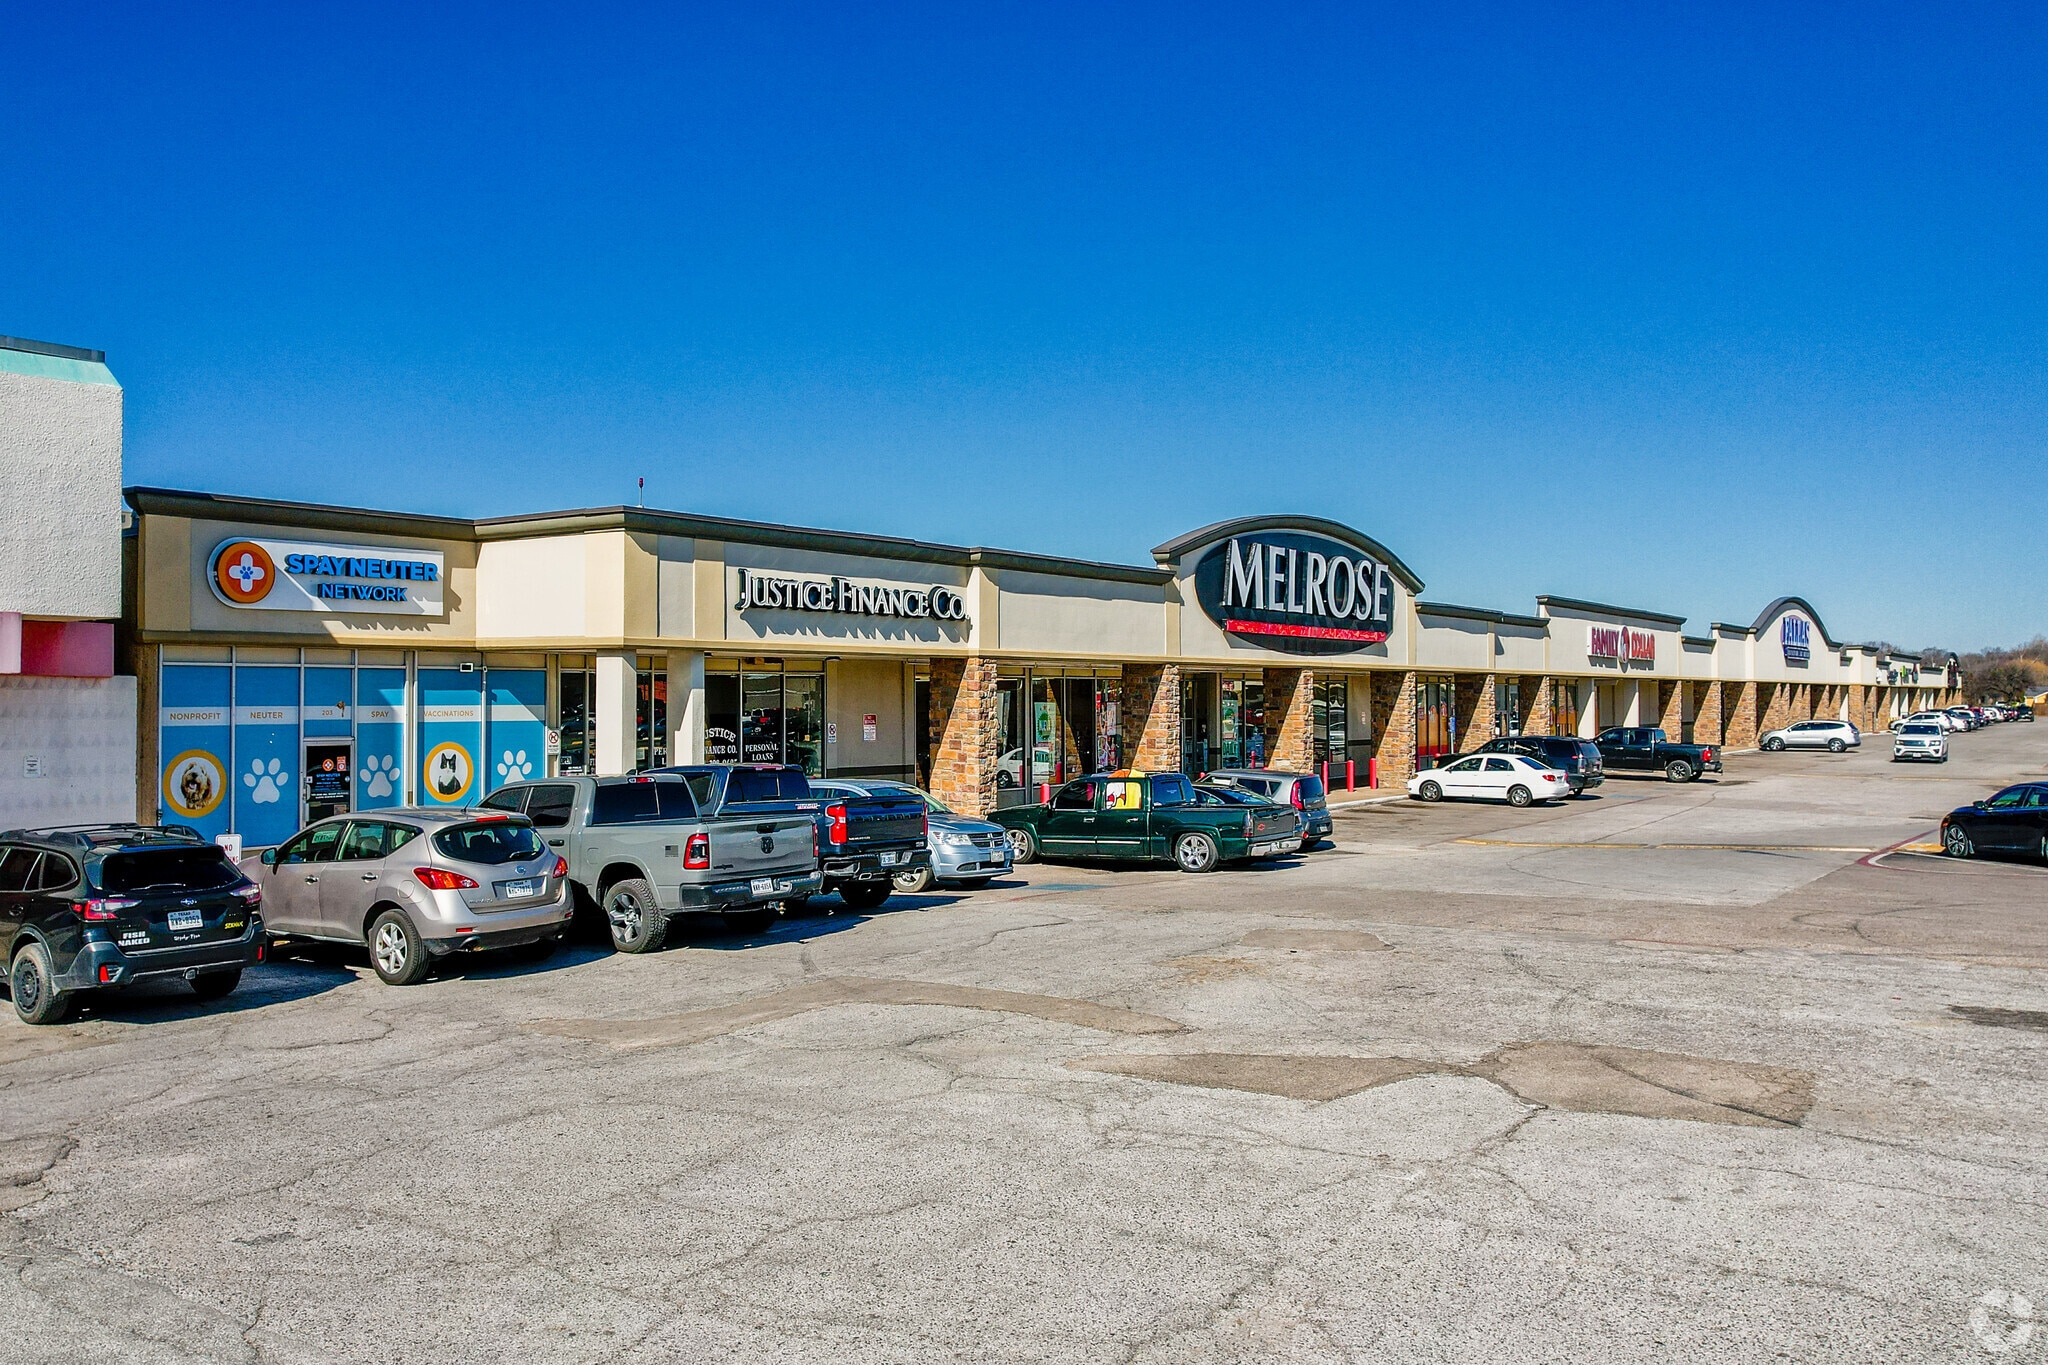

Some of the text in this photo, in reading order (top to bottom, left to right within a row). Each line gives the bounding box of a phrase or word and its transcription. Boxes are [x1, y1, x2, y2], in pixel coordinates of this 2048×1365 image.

[285, 553, 439, 582] SPAY NEUTER
[1224, 538, 1389, 622] MELROSE
[319, 583, 408, 602] NETWORK
[737, 568, 834, 611] JUSTICE
[835, 577, 930, 618] FINANCE
[1591, 626, 1656, 660] FAMILY DOLLAR
[169, 712, 222, 721] NONPROFIT
[249, 711, 283, 719] NEUTER
[370, 710, 389, 718] SPAY
[423, 709, 474, 718] VACCINATIONS
[745, 742, 779, 752] PERSONAL
[752, 752, 774, 761] LOANS
[224, 844, 233, 852] NO
[122, 930, 146, 940] FISH
[117, 937, 150, 947] NAKED
